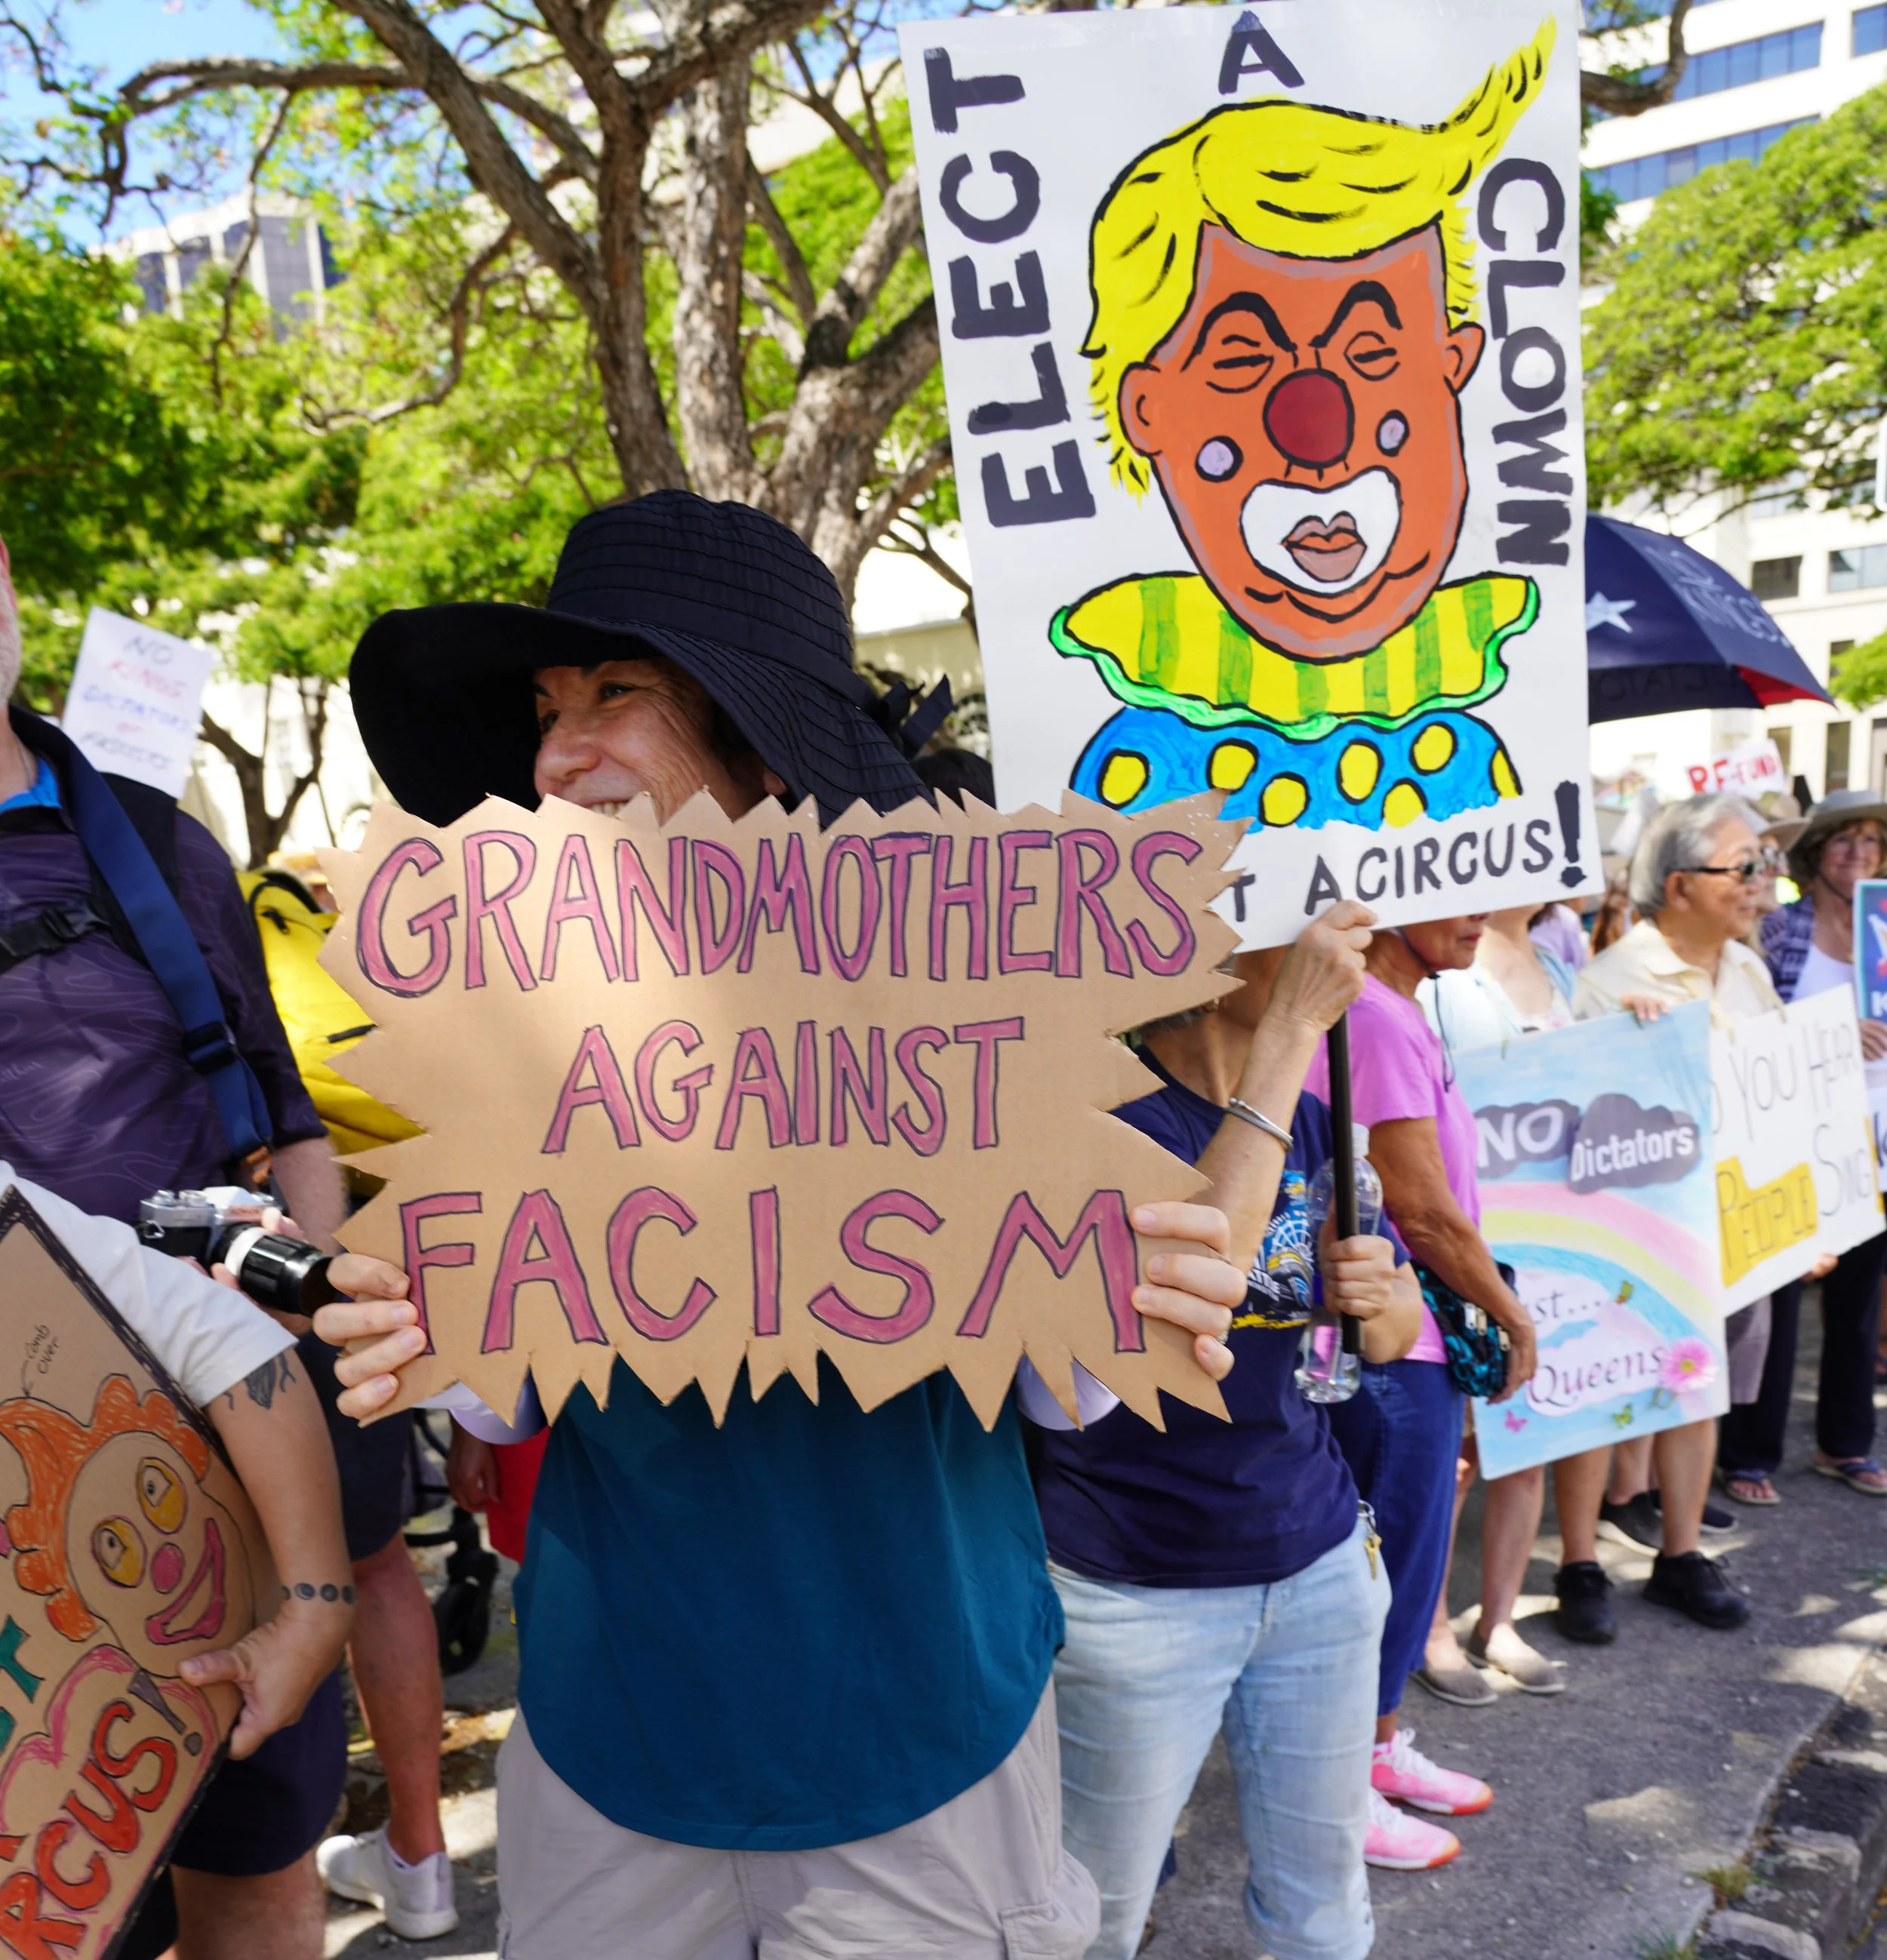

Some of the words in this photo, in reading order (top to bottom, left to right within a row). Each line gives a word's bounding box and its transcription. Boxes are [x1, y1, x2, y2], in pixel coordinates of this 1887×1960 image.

[1217, 10, 1304, 94] A
[924, 47, 1096, 528] ELECT
[1477, 158, 1573, 566] CLOWN
[1356, 780, 1587, 903] CIRCUS!
[356, 829, 1203, 998] GRANDMOTHERS
[542, 1016, 1025, 1156] AGAINST
[1477, 1106, 1565, 1168] NO
[1570, 1125, 1695, 1183] Dictators
[399, 1186, 1146, 1355] FACISM
[1530, 1346, 1667, 1408] Queens
[0, 1666, 203, 1960] RCUS!
